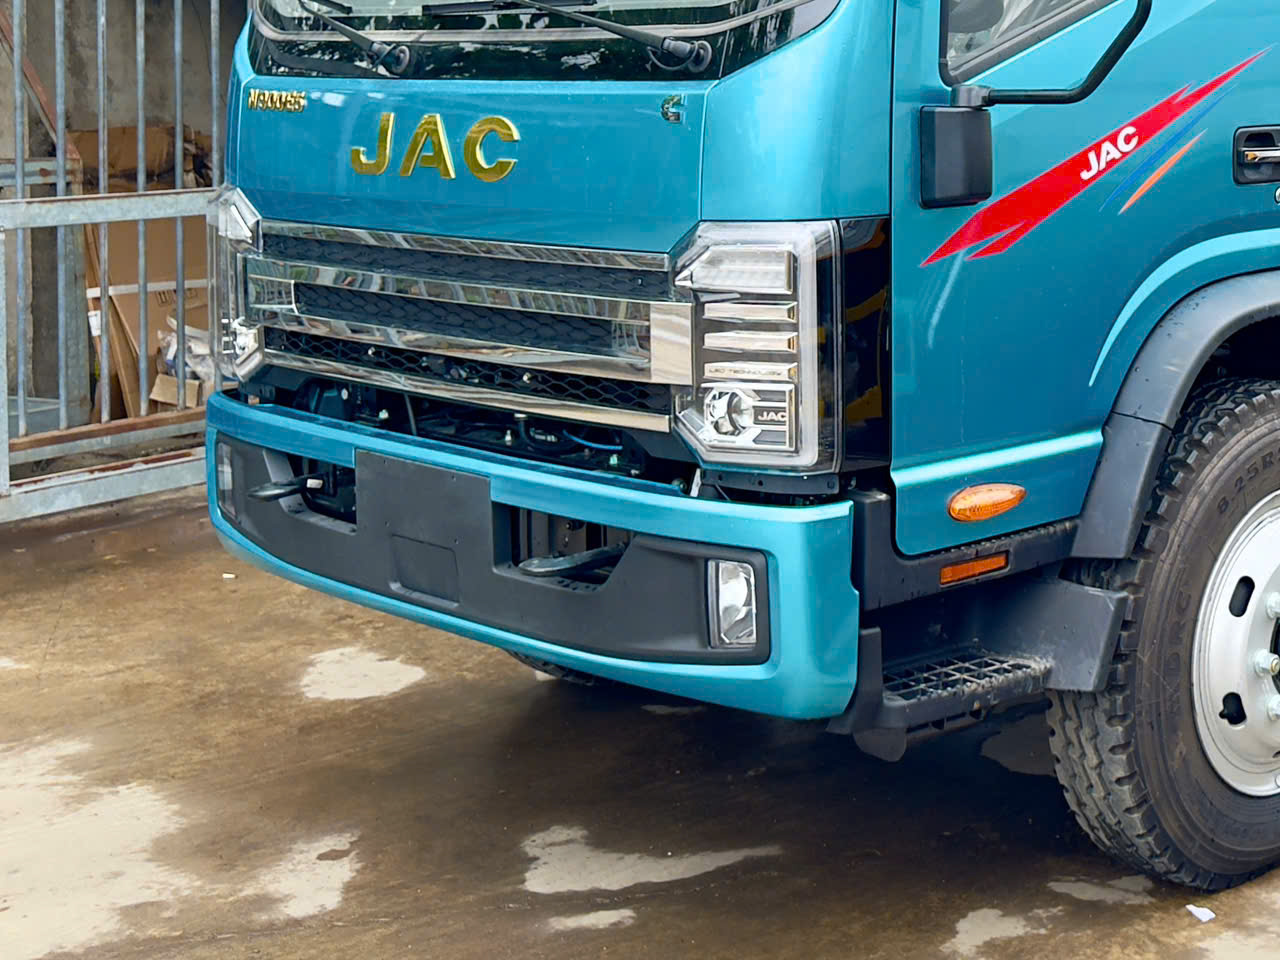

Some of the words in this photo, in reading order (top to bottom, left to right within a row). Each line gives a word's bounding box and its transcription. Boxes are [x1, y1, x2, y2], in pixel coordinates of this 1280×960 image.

[351, 112, 521, 183] JAC
[1080, 126, 1139, 180] JAC
[758, 411, 787, 421] JAC
